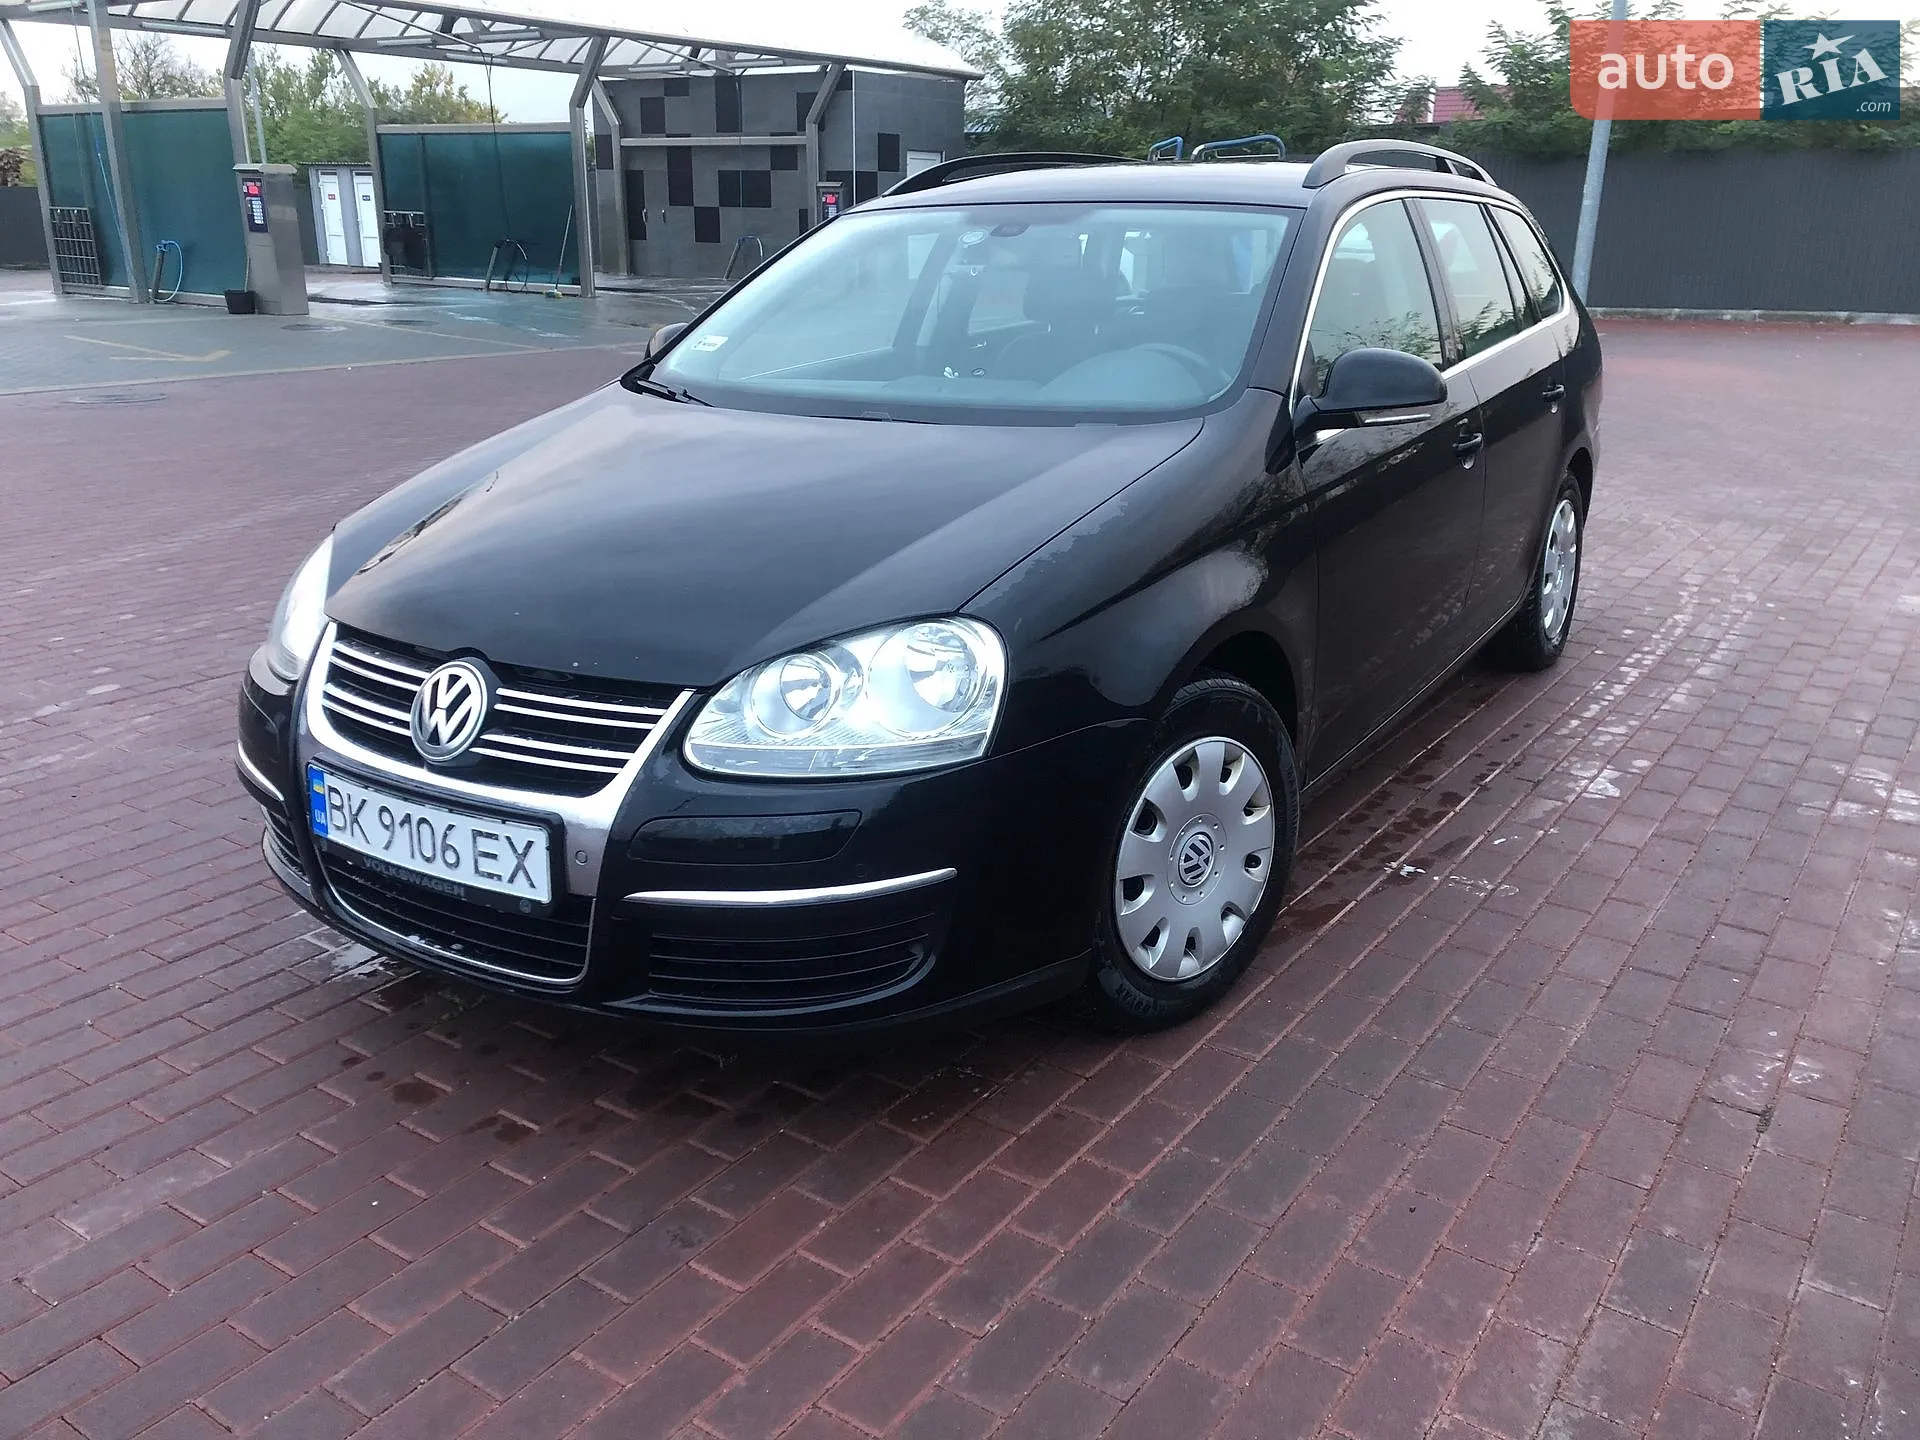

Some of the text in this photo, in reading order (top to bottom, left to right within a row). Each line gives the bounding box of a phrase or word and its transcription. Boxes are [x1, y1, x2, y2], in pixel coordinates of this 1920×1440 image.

[313, 808, 327, 826] UA
[327, 784, 537, 889] BK 9106 EX
[362, 856, 466, 898] VOLKSWAGEN
